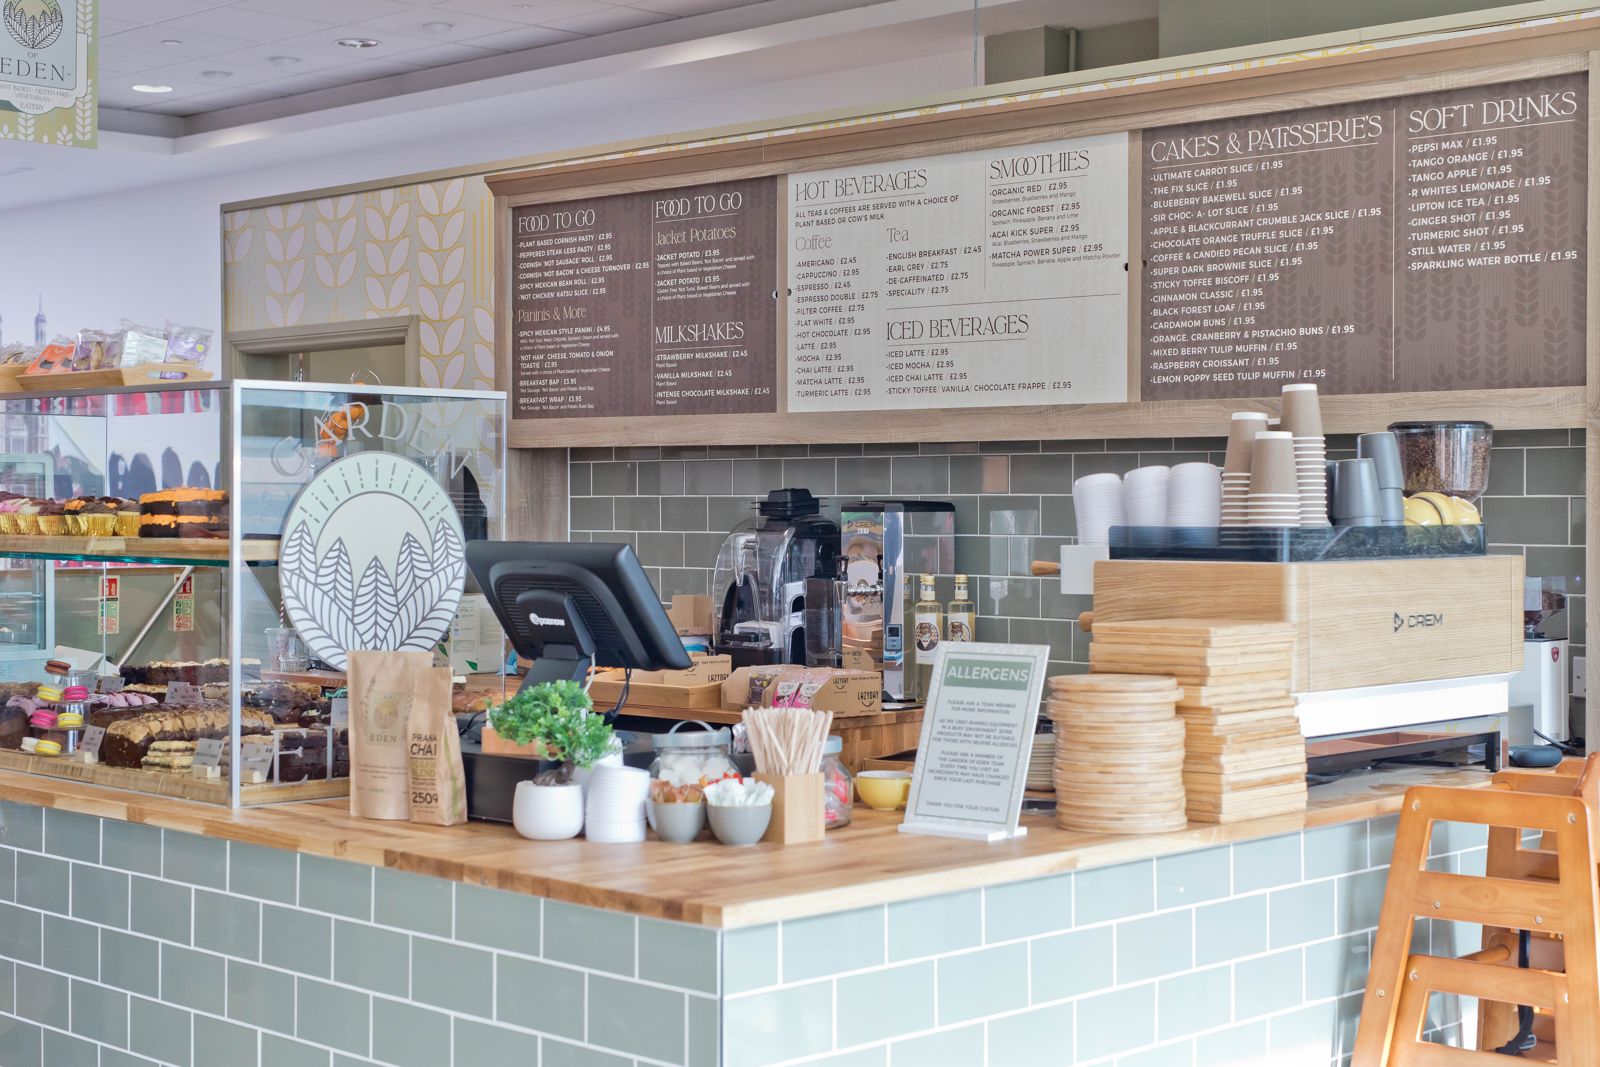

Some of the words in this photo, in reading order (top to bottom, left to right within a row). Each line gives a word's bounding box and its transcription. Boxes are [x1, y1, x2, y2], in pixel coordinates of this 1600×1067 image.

[1409, 103, 1473, 132] SOFT
[1482, 91, 1576, 126] DRINKS
[1151, 134, 1219, 162] CAKES
[1226, 132, 1240, 155] &
[1442, 139, 1462, 149] MAX
[1472, 135, 1496, 146] £1.95
[1447, 152, 1487, 164] ORANGE
[1498, 148, 1522, 158] £1.95
[990, 149, 1089, 179] SMOOTHIES
[1194, 166, 1227, 177] CARROT
[1230, 163, 1252, 173] SLICE
[1261, 160, 1282, 169] £1.95
[1447, 168, 1476, 178] APPLE
[1487, 164, 1511, 174] £1.95
[796, 180, 829, 201] HOT
[835, 168, 926, 196] BEVERAGES
[1027, 184, 1041, 192] RED
[1049, 181, 1067, 190] £2.95
[1171, 184, 1183, 192] FIX
[1186, 182, 1208, 191] SLICE
[1216, 179, 1236, 188] £1.95
[1421, 185, 1456, 196] WHITES
[1460, 179, 1514, 192] LEMONADE
[1525, 175, 1550, 186] £1.95
[1203, 192, 1246, 203] BAKEWELL
[1249, 189, 1271, 199] SLICE
[1280, 186, 1302, 195] £1.95
[1448, 199, 1462, 208] ICE
[1466, 197, 1484, 206] TEA
[1494, 194, 1519, 204] £1.95
[656, 197, 690, 218] FOOD
[694, 194, 715, 213] TO
[719, 191, 741, 210] GO
[1027, 204, 1054, 214] FOREST
[1061, 202, 1080, 210] £2.95
[519, 214, 549, 233] FOOD
[553, 211, 571, 229] TO
[575, 208, 595, 226] GO
[816, 218, 835, 226] BASED
[848, 214, 867, 222] COW'S
[1188, 219, 1253, 232] BLACKCURRANT
[1256, 215, 1296, 226] CRUMBLE
[1300, 213, 1321, 222] JACK
[1325, 210, 1349, 220] SLICE
[1358, 207, 1381, 217] £1.95
[655, 229, 685, 245] Jacket
[690, 224, 736, 242] Potatoes
[886, 226, 908, 242] Tea
[1203, 234, 1237, 244] ORANGE
[1240, 231, 1276, 241] TRUFFLE
[1279, 228, 1302, 238] SLICE
[1311, 226, 1333, 235] £1.95
[1463, 227, 1488, 236] SHOT
[1498, 224, 1523, 234] £1.95
[795, 233, 831, 251] Coffee
[918, 248, 957, 257] BREAKFAST
[964, 245, 981, 253] £2.45
[1023, 248, 1049, 256] POWER
[1052, 245, 1075, 254] SUPER
[1083, 243, 1102, 252] £2.95
[840, 256, 856, 264] £2.45
[931, 261, 948, 269] £2.75
[1182, 264, 1203, 273] DARK
[1207, 261, 1245, 271] BROWNIE
[1249, 259, 1271, 268] SLICE
[1280, 256, 1302, 266] £1.95
[1467, 256, 1500, 266] WATER
[1504, 253, 1540, 263] BOTTLE
[1551, 250, 1576, 260] £1.95
[843, 268, 859, 276] £2.95
[1200, 290, 1232, 299] CLASSIC
[1241, 288, 1262, 296] £1.95
[839, 316, 854, 324] £2.95
[887, 320, 923, 340] ICED
[930, 314, 1028, 337] BEVERAGES
[1203, 318, 1225, 326] BUNS
[1234, 316, 1254, 325] £1.95
[655, 321, 743, 343] MILKSHAKES
[1202, 358, 1249, 367] CROISSANT
[1257, 357, 1278, 365] £1.95
[681, 370, 712, 378] MILKSHAKE
[1407, 613, 1443, 628] CREM
[946, 665, 1029, 683] ALLERGENS
[857, 690, 879, 701] LAZYDAY
[410, 743, 438, 756] CHAI
[411, 791, 439, 805] 250g
